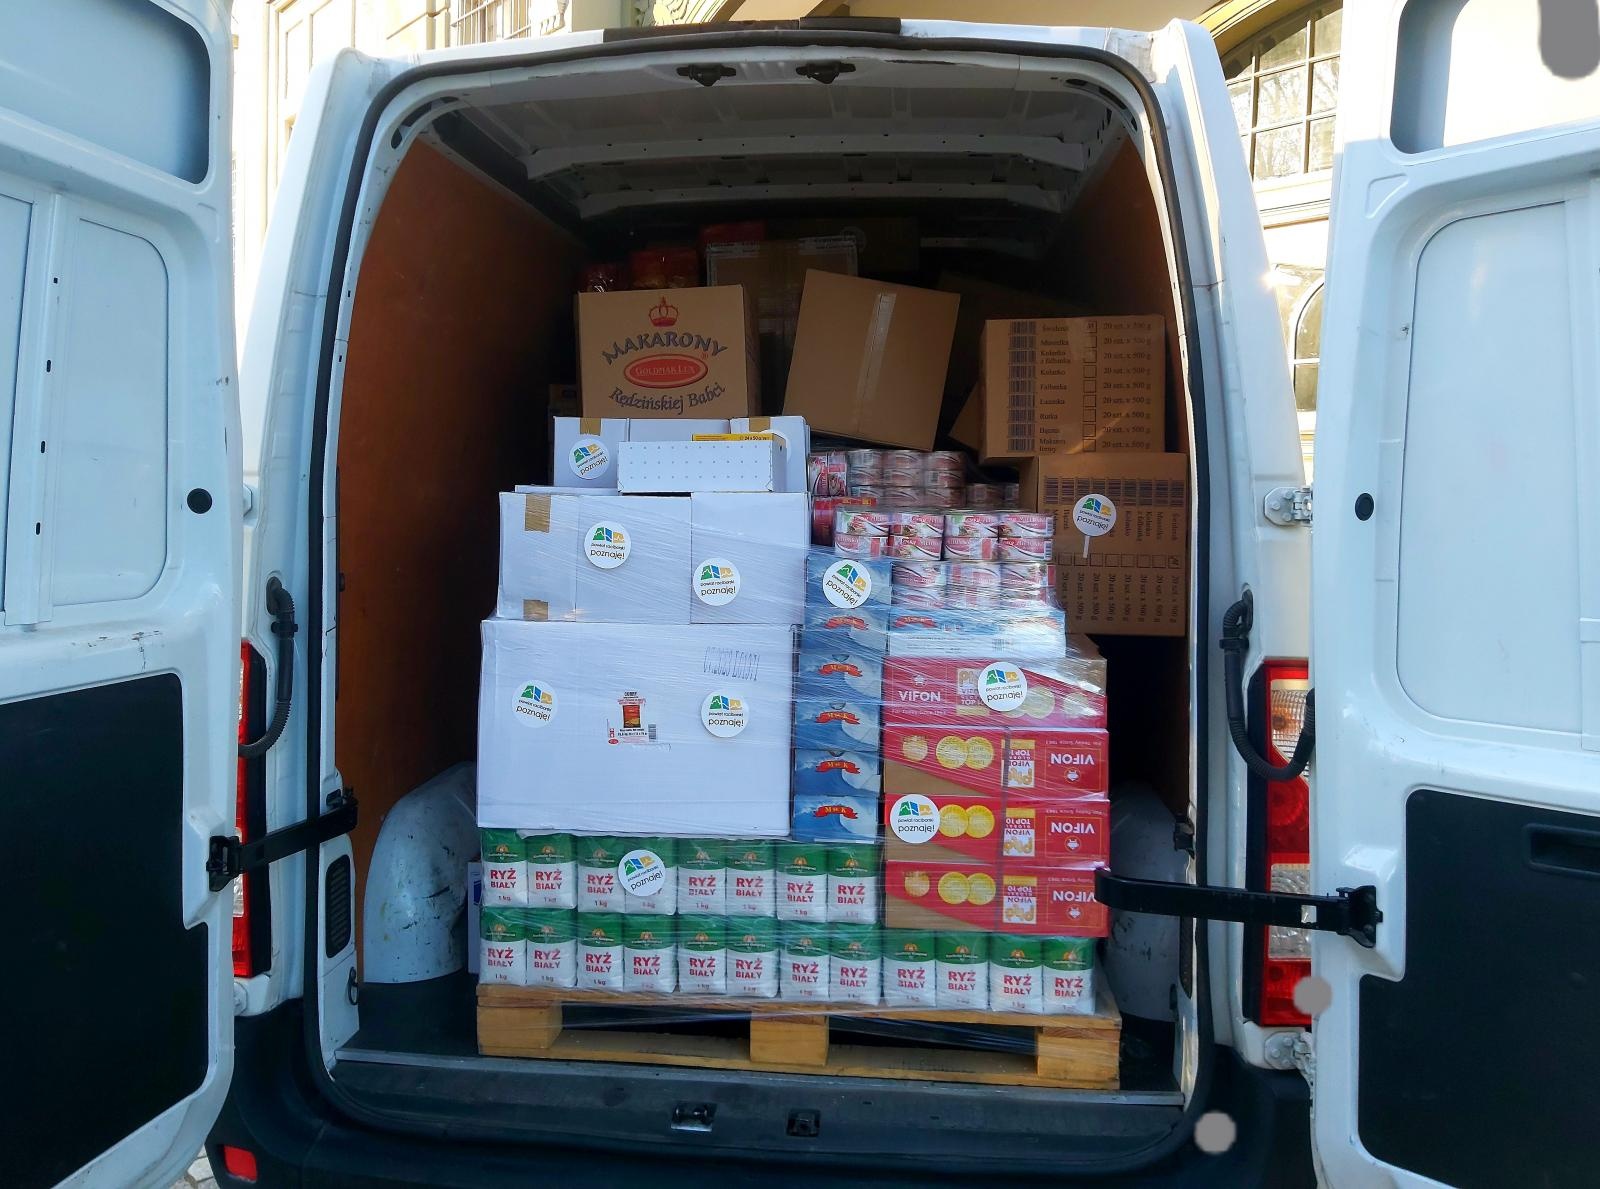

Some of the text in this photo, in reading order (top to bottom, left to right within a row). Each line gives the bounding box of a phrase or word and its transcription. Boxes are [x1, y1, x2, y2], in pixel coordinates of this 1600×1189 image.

[602, 331, 728, 365] MAKARONY
[687, 382, 726, 408] Babci
[590, 549, 625, 560] poznaję!
[701, 586, 736, 597] poznaję!
[826, 580, 858, 605] poznaję!
[898, 690, 941, 702] VIFON
[986, 691, 1023, 702] poznaję!
[516, 705, 551, 721] poznaję!
[708, 719, 744, 728] poznaję!
[1050, 753, 1095, 765] VIFON
[898, 825, 935, 833] poznaję!
[1051, 822, 1095, 834] VIFON
[490, 867, 517, 880] RYŻ
[535, 868, 563, 882] RYŻ
[587, 873, 614, 886] RYŻ
[490, 881, 517, 889] BIAŁY
[535, 882, 562, 890] BIAŁY
[630, 870, 663, 892] poznaję!
[688, 875, 716, 887] RYŻ
[736, 876, 764, 888] RYŻ
[587, 886, 614, 894] BIAŁY
[688, 888, 716, 896] BIAŁY
[736, 889, 763, 897] BIAŁY
[787, 881, 814, 894] RYŻ
[837, 883, 865, 895] RYŻ
[787, 894, 814, 903] BIAŁY
[837, 896, 865, 905] BIAŁY
[1053, 890, 1097, 902] VIFON
[487, 947, 514, 959] RYŻ
[534, 948, 561, 960] RYŻ
[585, 952, 612, 964] RYŻ
[534, 961, 561, 969] BIAŁY
[633, 954, 661, 967] RYŻ
[689, 956, 716, 968] RYŻ
[735, 958, 763, 970] RYŻ
[585, 965, 612, 973] BIAŁY
[633, 967, 660, 975] BIAŁY
[689, 969, 715, 977] BIAŁY
[792, 961, 819, 974] RYŻ
[840, 966, 868, 978] RYŻ
[897, 967, 926, 979] RYŻ
[735, 971, 762, 979] BIAŁY
[791, 975, 818, 983] BIAŁY
[948, 969, 977, 982] RYŻ
[1003, 973, 1032, 986] RYŻ
[840, 979, 867, 988] BIAŁY
[897, 980, 925, 989] BIAŁY
[948, 982, 976, 991] BIAŁY
[1054, 976, 1084, 989] RYŻ
[1003, 986, 1032, 996] BIAŁY
[1054, 989, 1083, 998] BIAŁY
